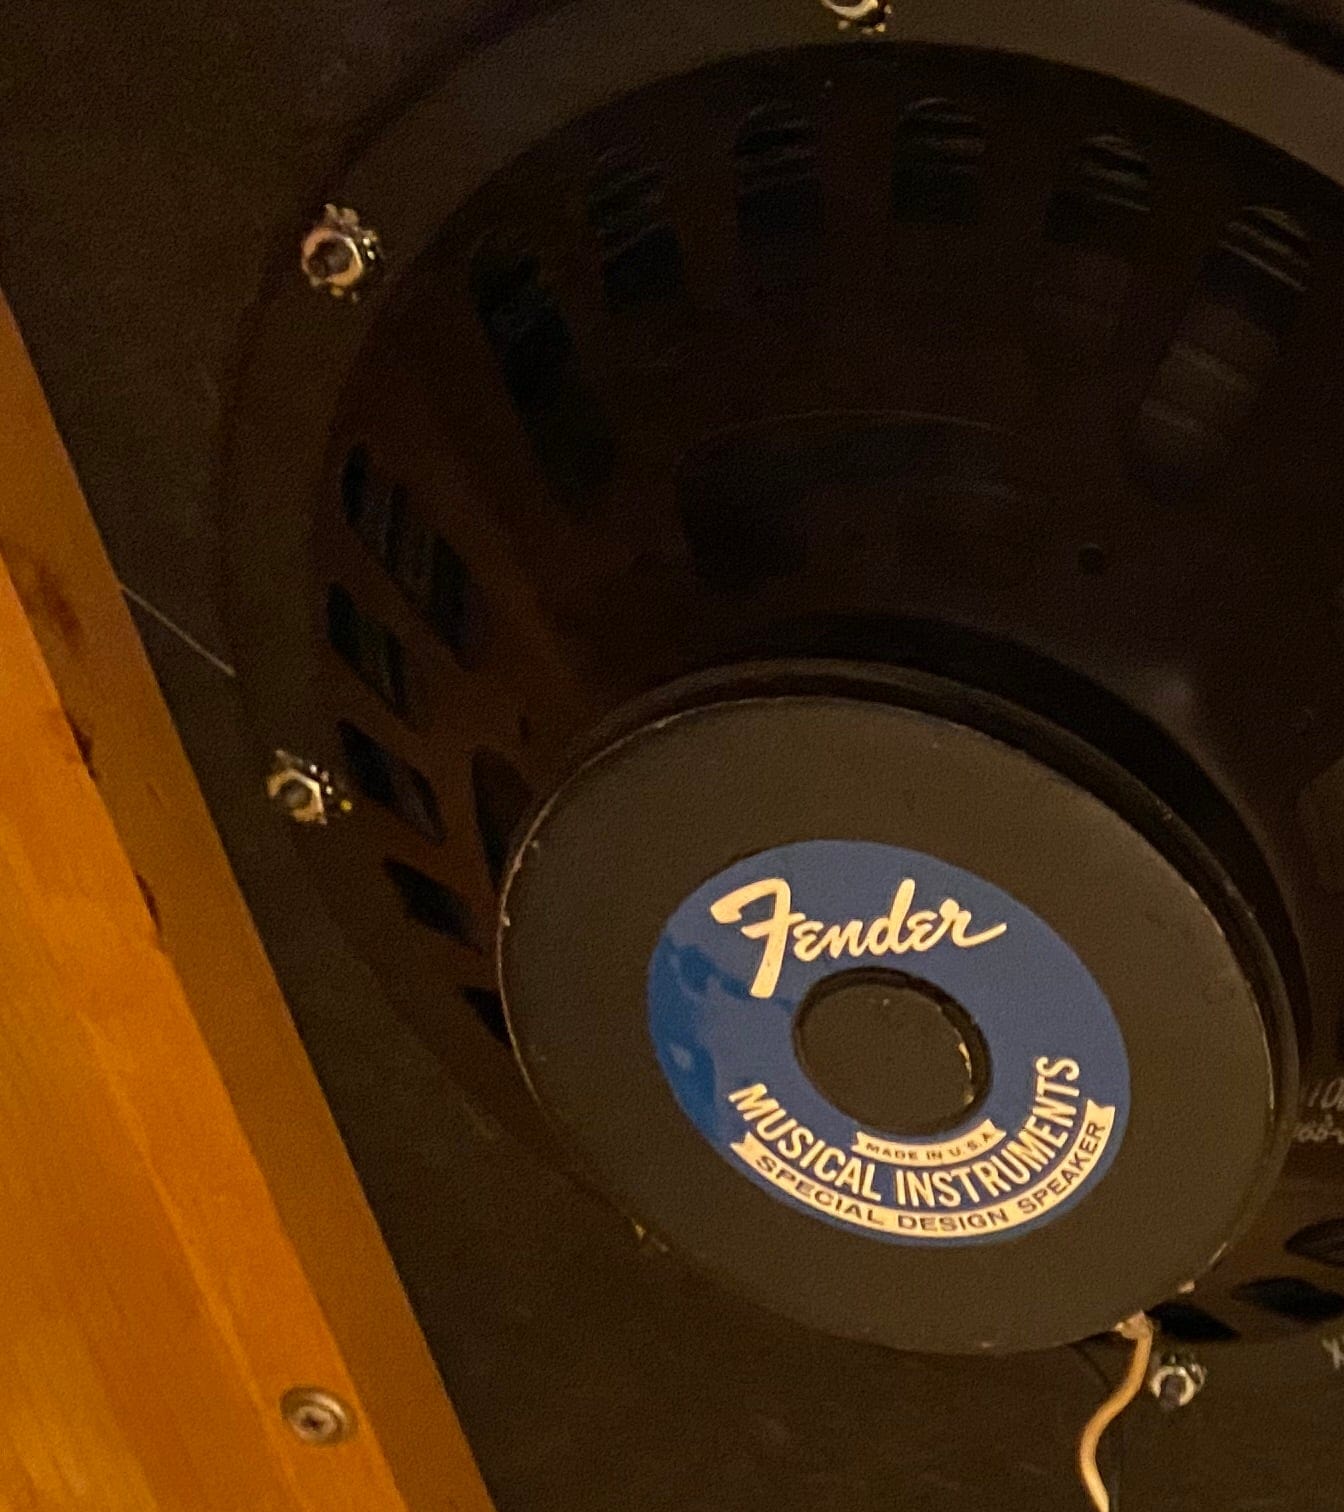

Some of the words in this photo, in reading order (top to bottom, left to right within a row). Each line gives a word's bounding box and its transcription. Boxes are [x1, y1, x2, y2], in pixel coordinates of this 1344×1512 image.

[710, 878, 1007, 999] Fender
[728, 1083, 883, 1201] MUSICAL
[896, 1056, 1081, 1207] INSTRUMENTS
[754, 1155, 884, 1225] SPECIAL
[897, 1209, 1010, 1233] DESIGN
[1020, 1123, 1106, 1215] SPEAKER
[866, 1142, 918, 1161] MADE
[926, 1148, 943, 1161] IN
